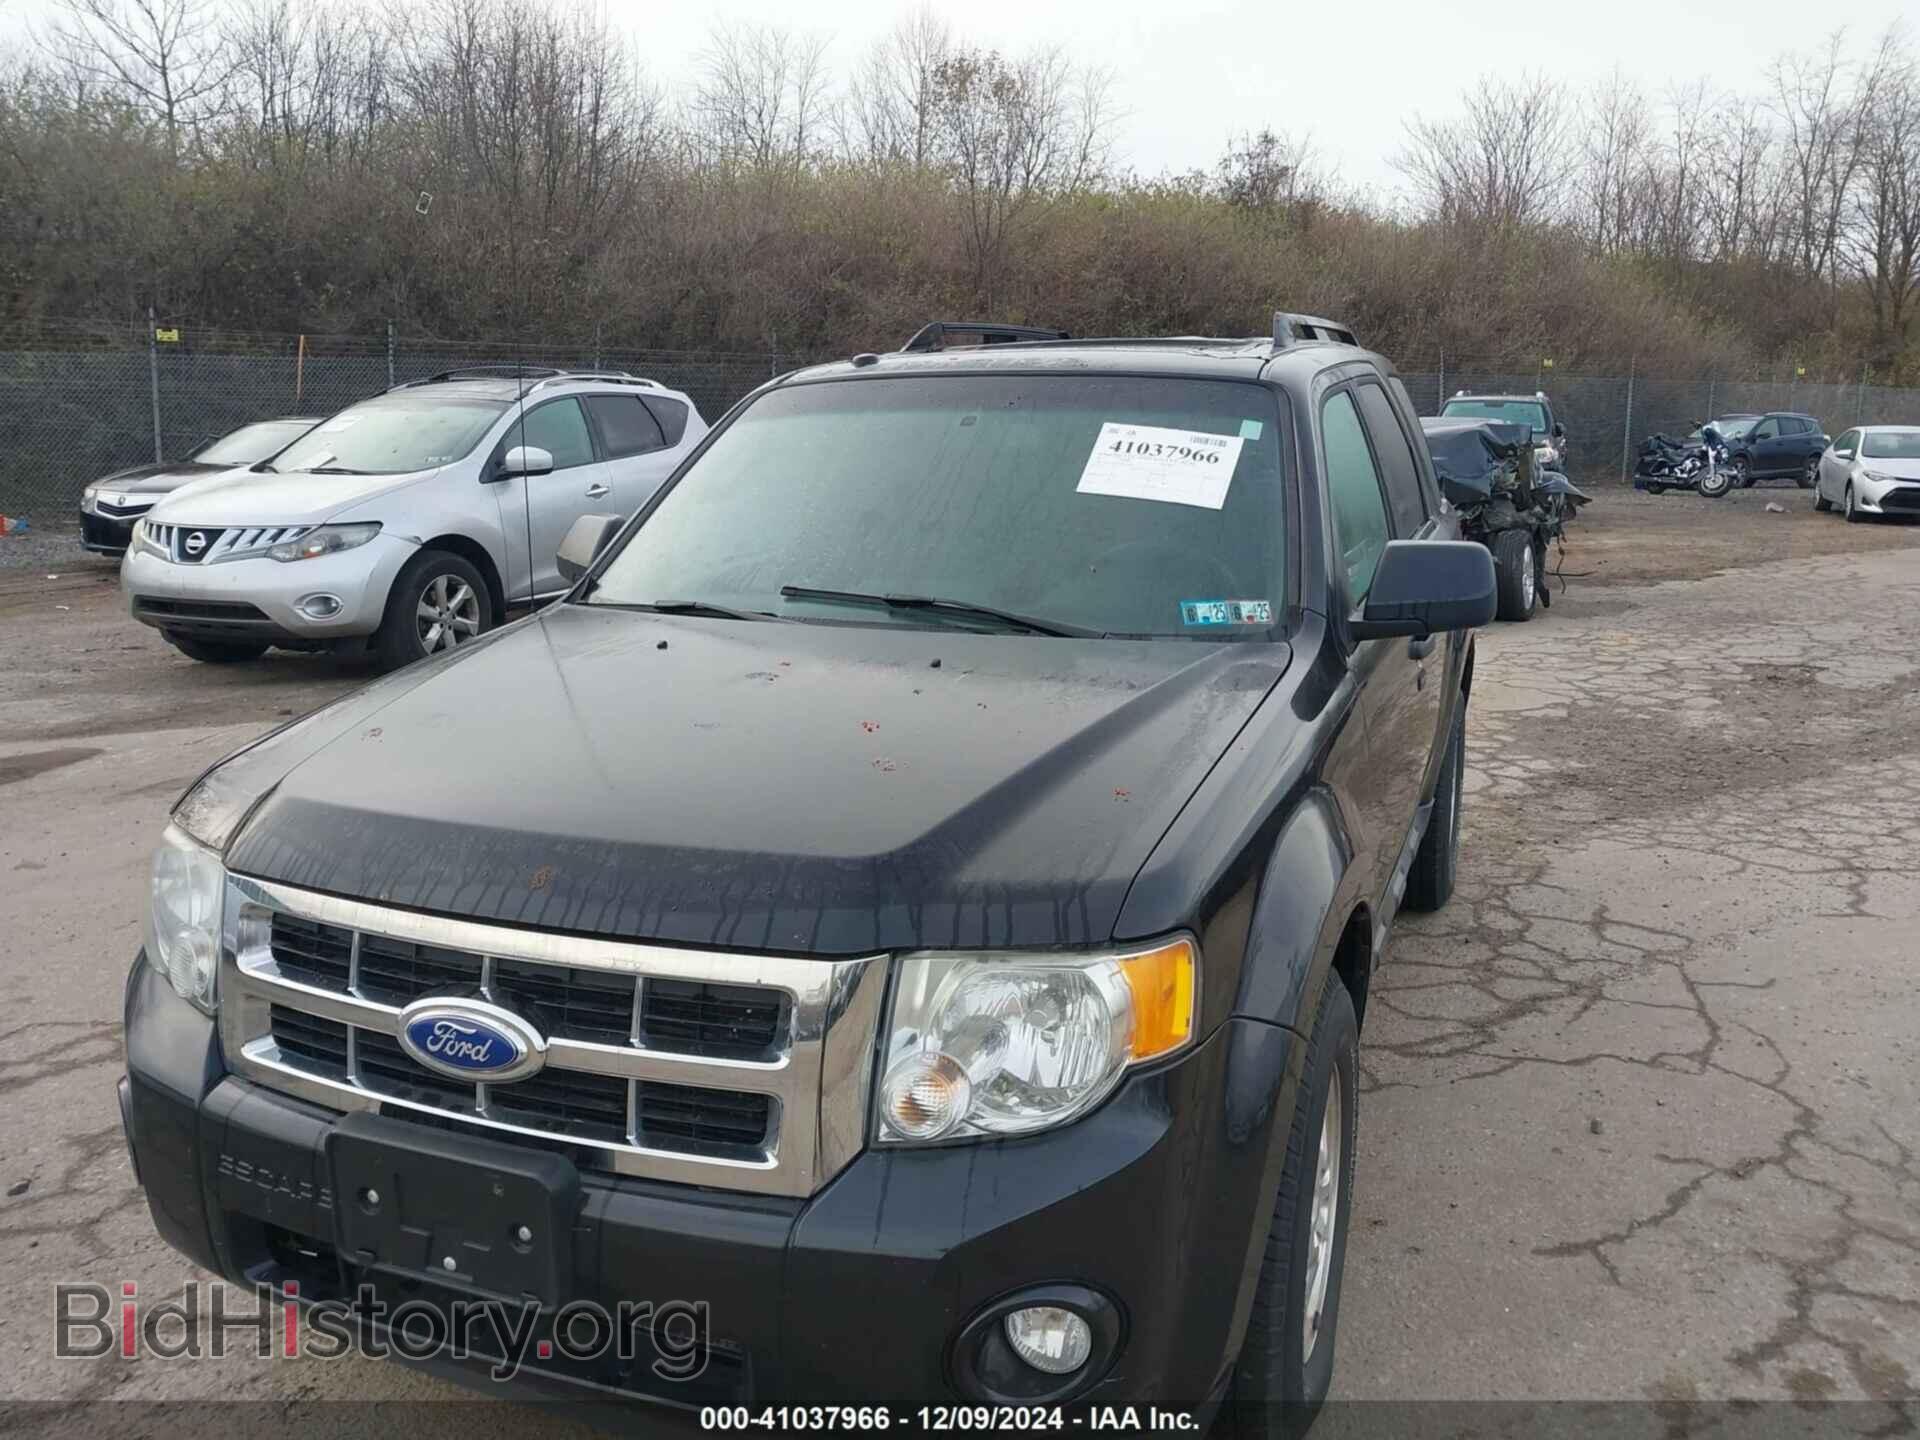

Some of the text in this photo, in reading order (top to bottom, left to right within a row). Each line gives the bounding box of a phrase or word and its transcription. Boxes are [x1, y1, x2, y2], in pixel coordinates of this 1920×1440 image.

[1109, 439, 1220, 465] 41037966
[426, 1021, 493, 1063] Ford
[218, 1154, 333, 1209] ESCAPE
